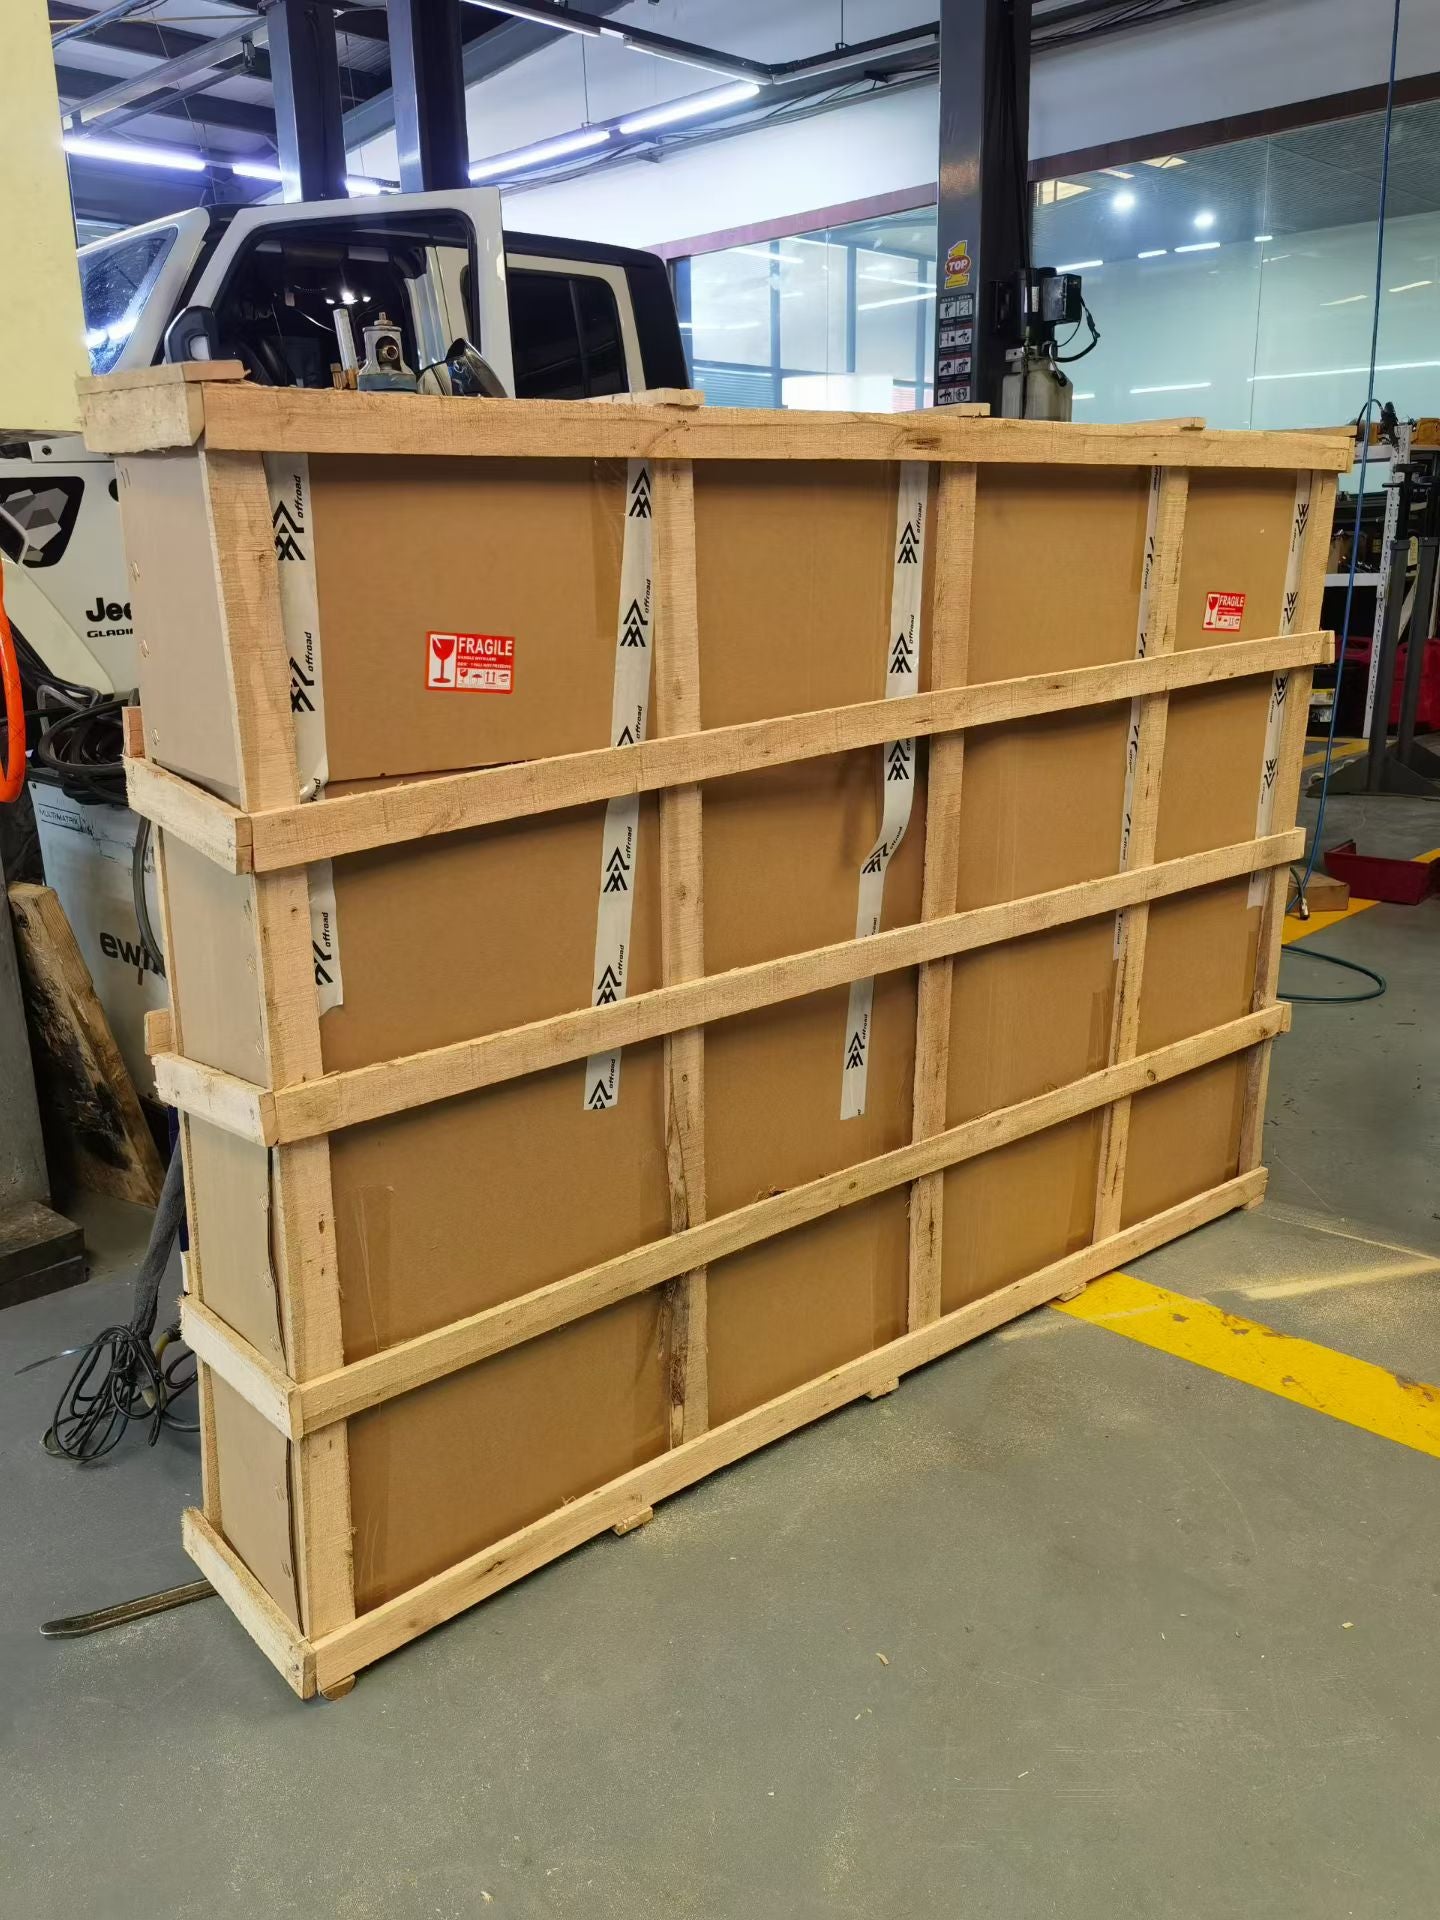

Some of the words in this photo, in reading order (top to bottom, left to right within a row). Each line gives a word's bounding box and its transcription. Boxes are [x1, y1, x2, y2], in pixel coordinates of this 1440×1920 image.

[948, 259, 968, 272] TOP
[293, 474, 304, 519] offroad
[643, 579, 652, 614] offroad
[1218, 595, 1244, 607] FRAGILE
[303, 631, 315, 672] offroad
[458, 637, 513, 656] FRAGILE
[635, 705, 643, 739] offroad
[322, 912, 332, 948] offroad
